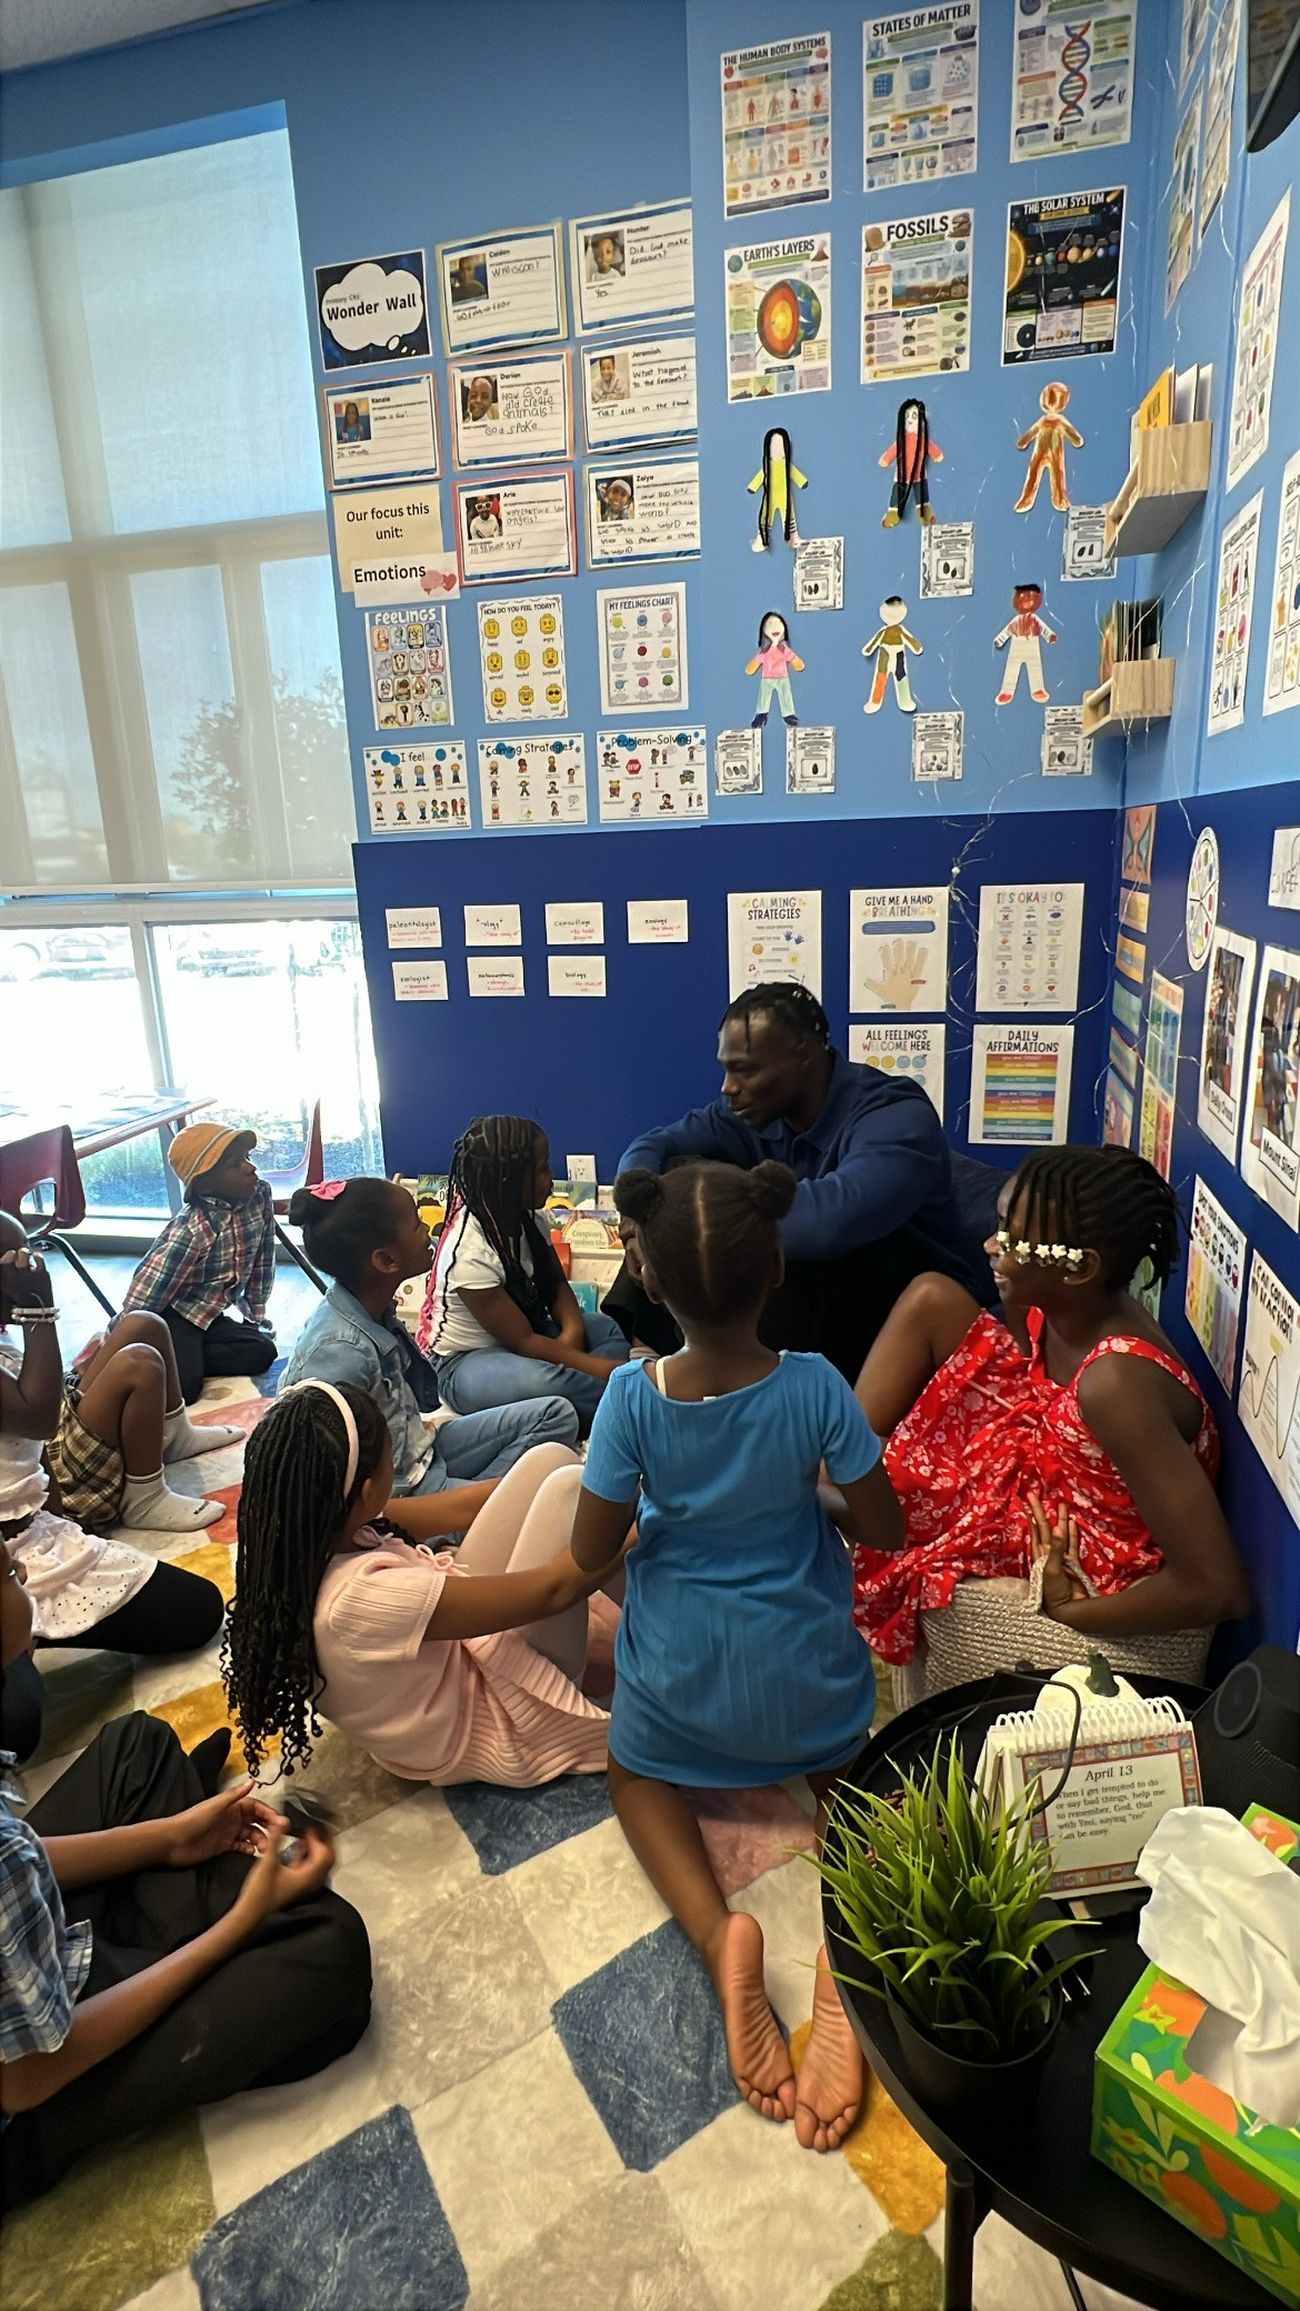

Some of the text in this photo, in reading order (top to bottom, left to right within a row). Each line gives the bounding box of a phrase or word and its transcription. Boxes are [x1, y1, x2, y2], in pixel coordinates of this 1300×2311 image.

[872, 17, 911, 37] STATES
[913, 13, 926, 26] OF
[928, 4, 971, 24] MATTER
[724, 55, 738, 66] THE
[739, 50, 768, 62] HUMAN
[770, 44, 790, 57] BODY
[792, 36, 826, 52] SYSTEMS
[1024, 203, 1039, 215] THE
[1041, 198, 1068, 212] SOLAR
[1070, 192, 1104, 208] SYSTEM
[886, 215, 948, 242] FOSSILS
[744, 239, 814, 262] EARTH'S LAYERS
[326, 293, 416, 321] Wonder Wall
[633, 368, 654, 378] What
[346, 502, 430, 523] Our focus this
[376, 526, 404, 540] unit:
[354, 564, 427, 583] Emotions
[609, 597, 674, 611] MY FEELINGS CHART
[400, 752, 425, 762] I feel
[752, 897, 797, 909] CALMING
[865, 894, 934, 906] GIVE ME A HAND
[1017, 892, 1048, 904] OKAY
[748, 908, 801, 920] STRATEGIES
[866, 1030, 928, 1040] ALL FEELINGS
[1008, 1030, 1039, 1041] DAILY
[862, 1040, 932, 1051] WELCOME HERE
[986, 1041, 1060, 1052] AFFIRMATIONS
[1084, 1765, 1133, 1782] April 13
[1086, 1788, 1099, 1797] get
[1101, 1781, 1135, 1792] tempted
[1067, 1800, 1081, 1809] say
[1083, 1797, 1099, 1805] bad
[1132, 1791, 1150, 1799] help
[1136, 1801, 1152, 1809] that
[1058, 1821, 1076, 1830] with
[1100, 1815, 1127, 1824] saying
